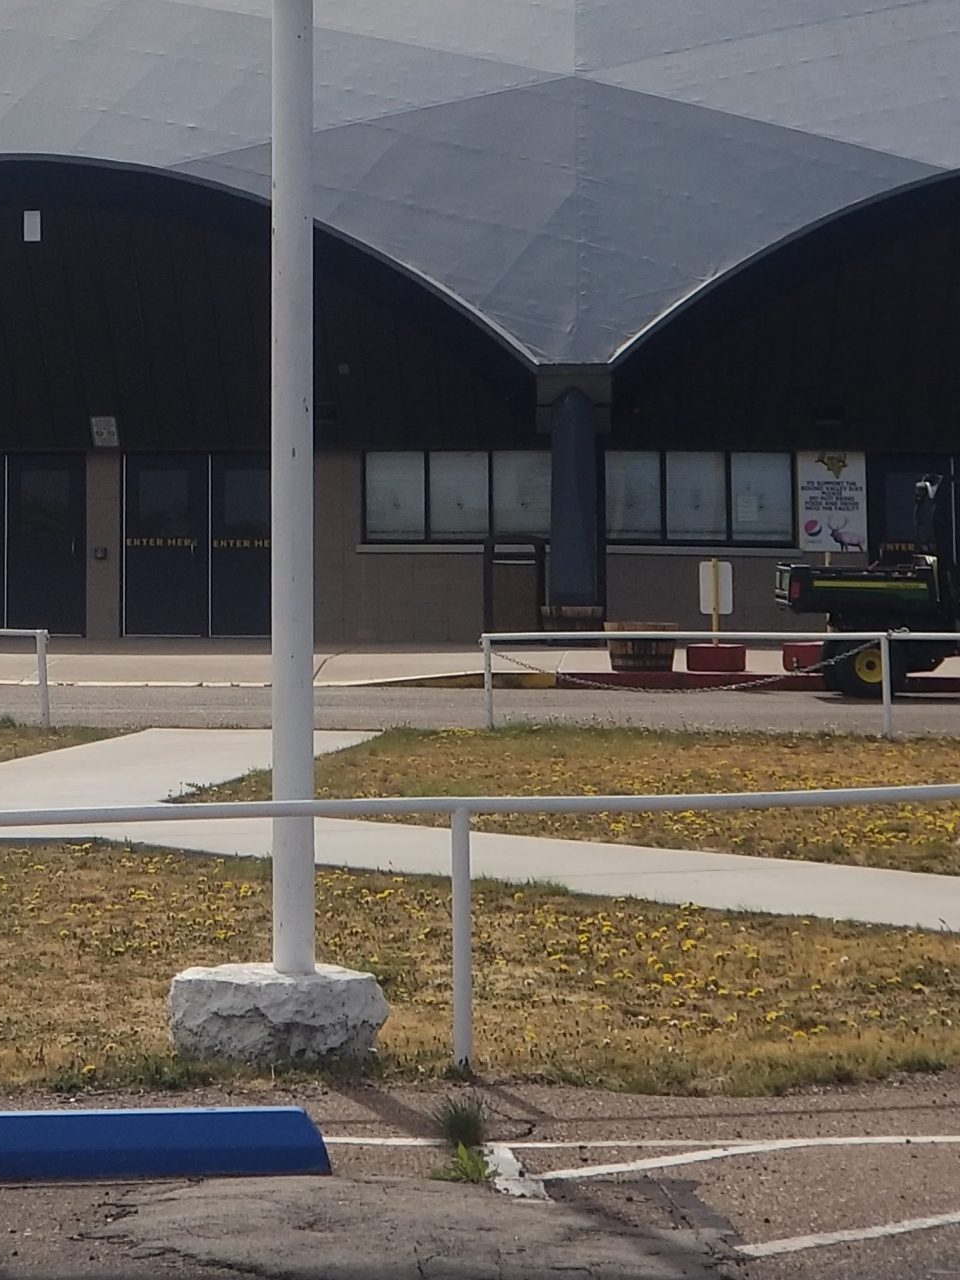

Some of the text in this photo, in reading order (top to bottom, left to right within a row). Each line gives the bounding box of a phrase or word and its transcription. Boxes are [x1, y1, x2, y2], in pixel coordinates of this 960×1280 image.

[126, 538, 161, 547] ENTER
[213, 540, 271, 548] ENTER HE
